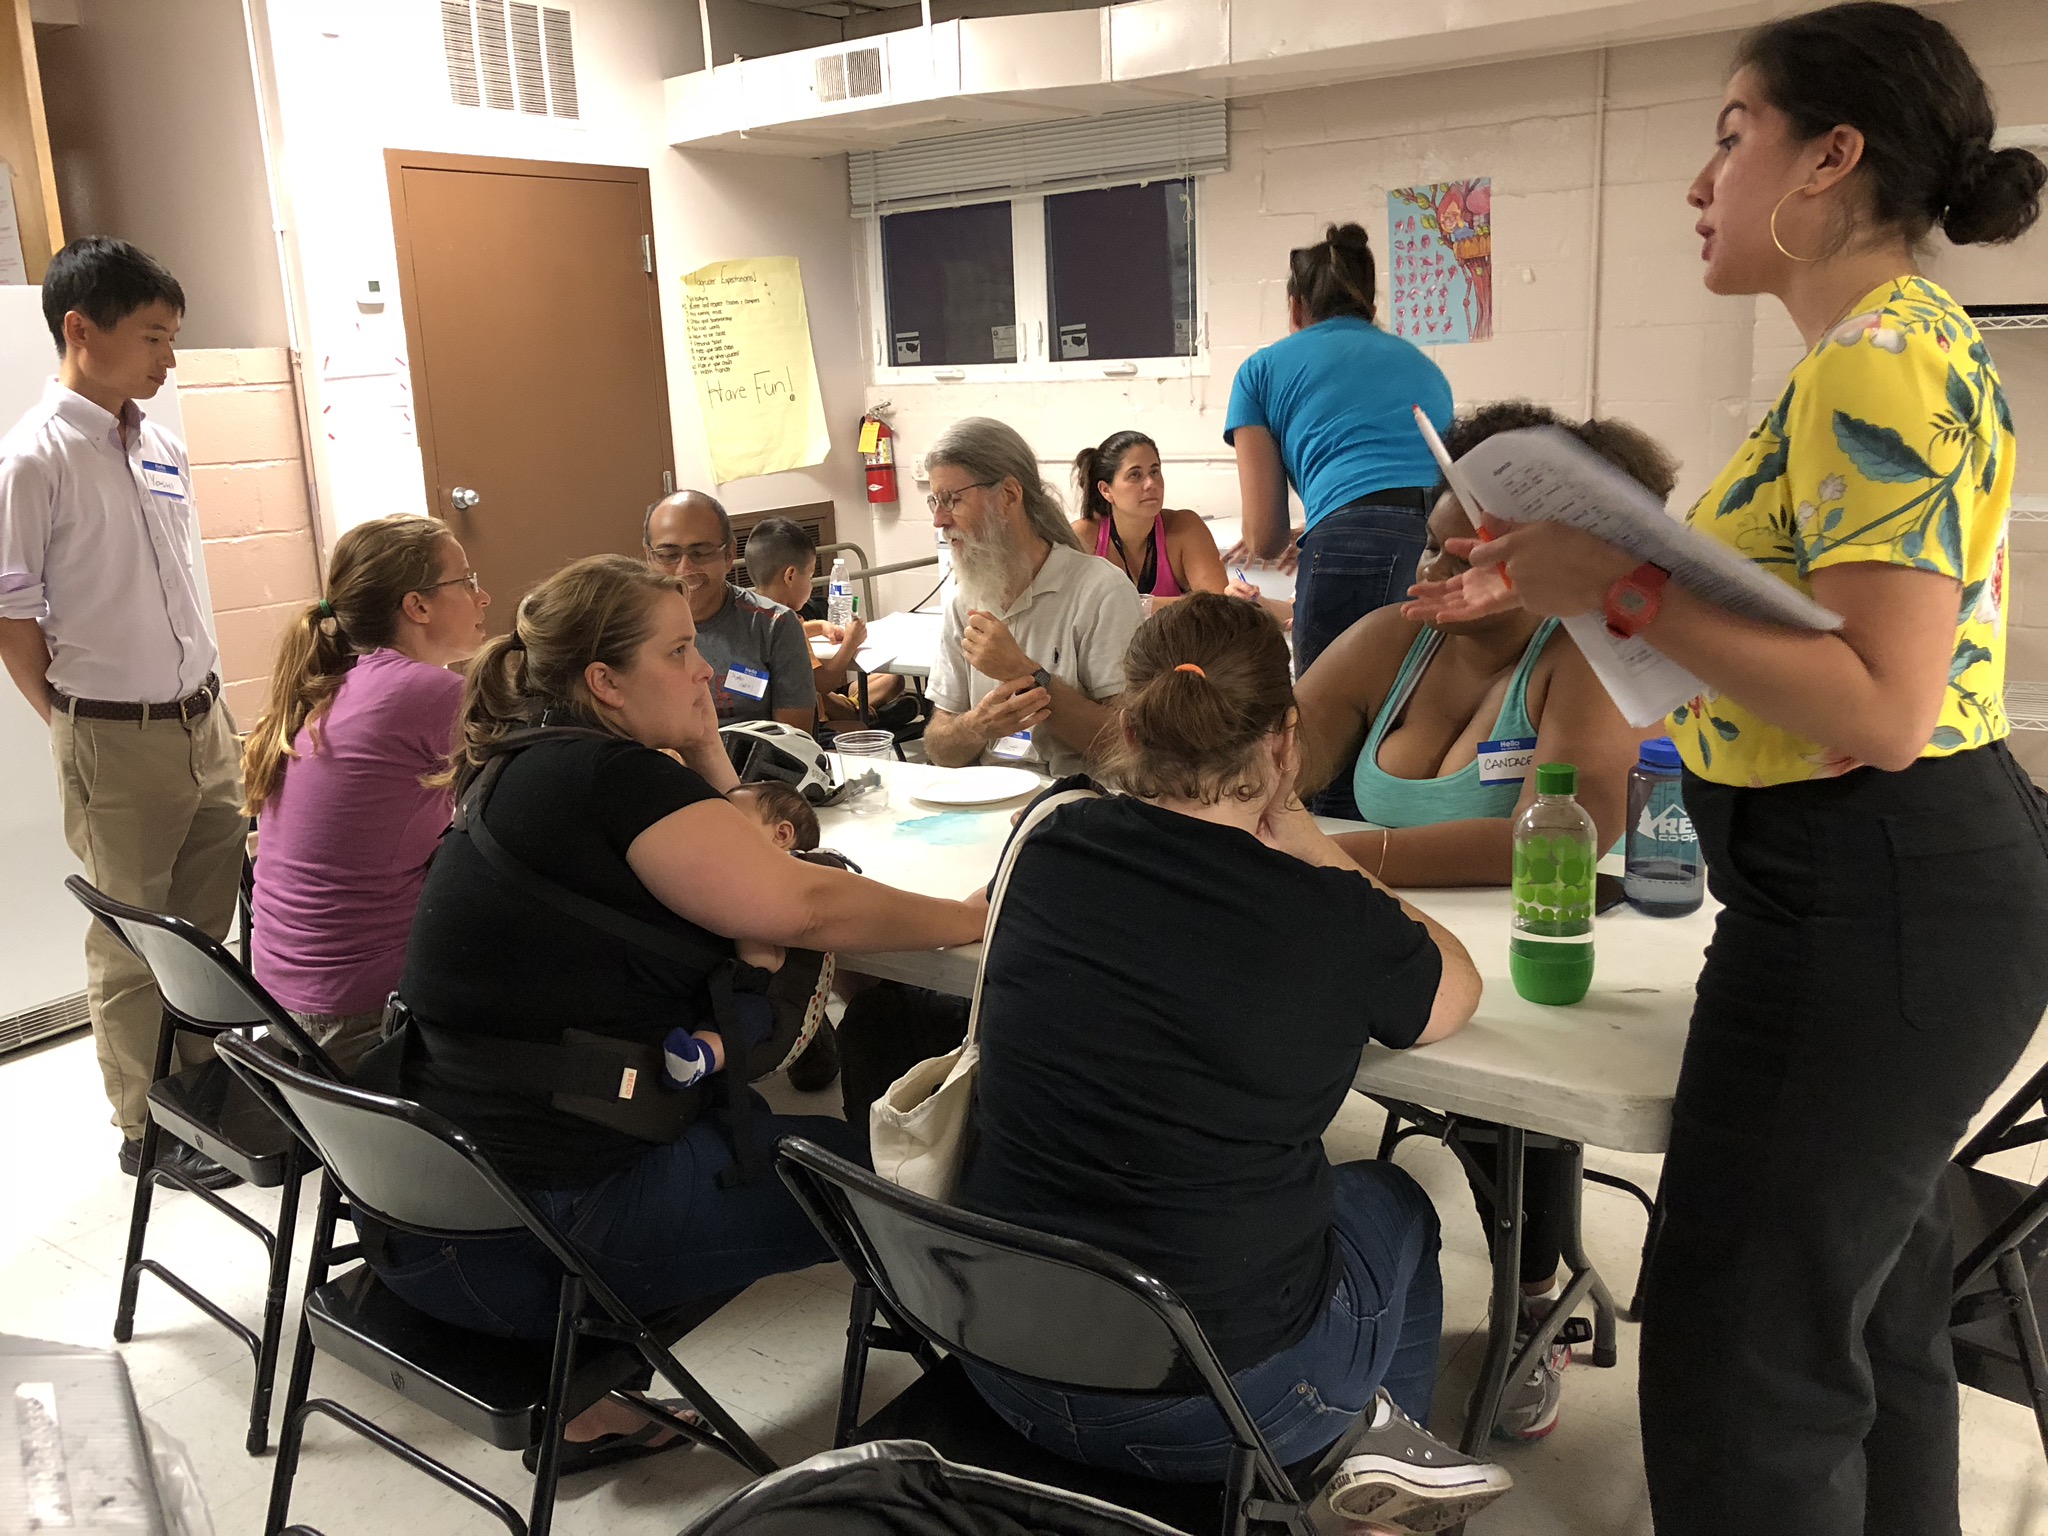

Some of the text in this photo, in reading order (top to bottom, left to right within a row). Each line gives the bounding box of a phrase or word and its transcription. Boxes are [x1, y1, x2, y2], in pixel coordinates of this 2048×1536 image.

[706, 366, 796, 409] Have Fun!
[1500, 740, 1520, 748] Hello
[1484, 755, 1533, 771] CANDACE
[1658, 817, 1696, 834] RE
